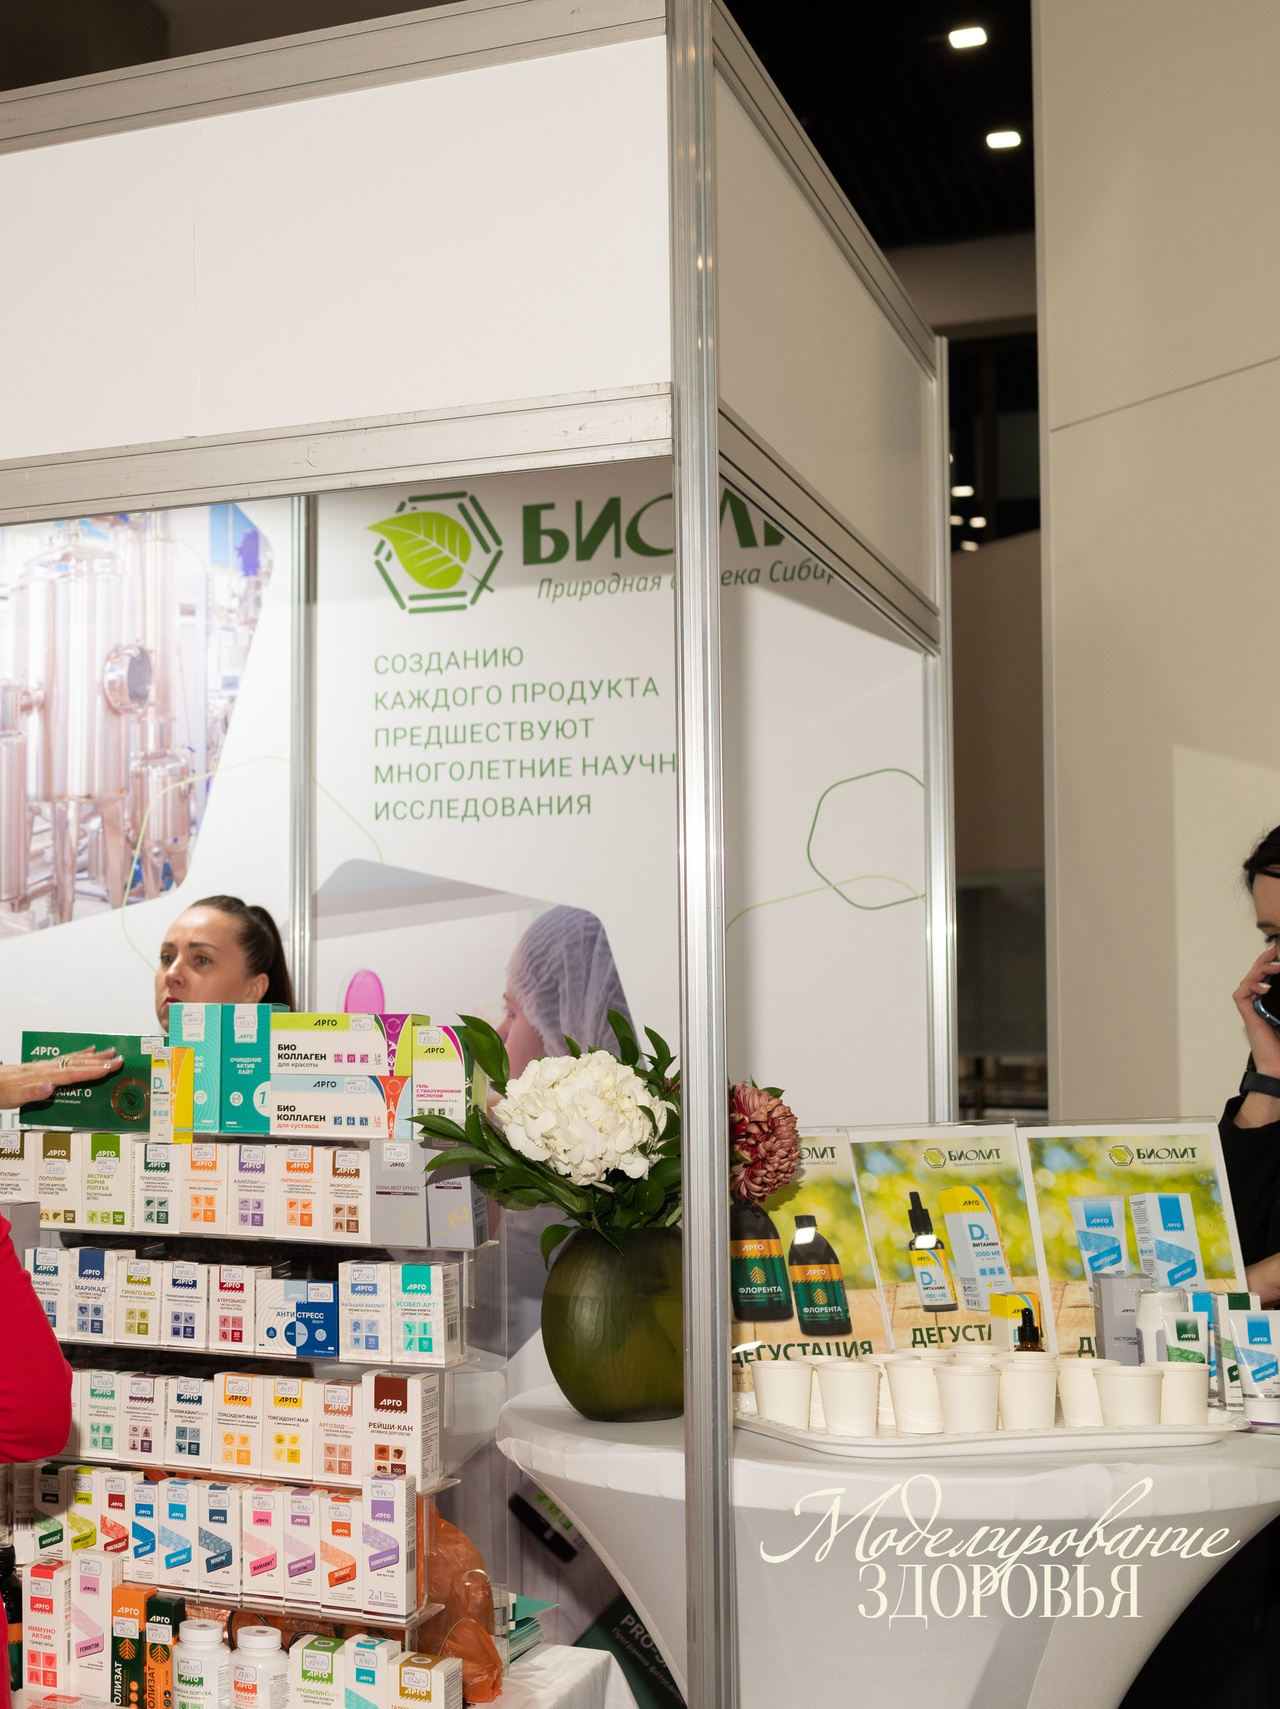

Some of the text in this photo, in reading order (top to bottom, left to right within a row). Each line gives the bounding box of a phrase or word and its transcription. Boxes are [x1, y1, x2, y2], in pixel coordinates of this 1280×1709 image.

[522, 487, 788, 567] БИОЛ
[537, 572, 662, 604] Природная
[769, 556, 839, 584] Сибир
[373, 646, 524, 676] СОЗДАНИЮ
[373, 676, 660, 714] КАЖДОГО ПРОДУКТА
[373, 717, 595, 750] ПРЕДШЕСТВУЮТ
[373, 752, 678, 787] МНОГОЛЕТНИЕ НАУЧН
[373, 794, 592, 822] ИССЛЕДОВАНИЯ
[313, 1019, 338, 1027] АРГО
[30, 1046, 60, 1056] АРГО
[277, 1052, 327, 1061] КОЛЛАГЕН
[259, 1091, 266, 1104] 1
[276, 1114, 326, 1122] КОЛЛАГЕН
[948, 1148, 1001, 1162] БИОЛИТ
[1136, 1147, 1197, 1160] БИОЛИТ
[741, 1244, 765, 1252] АРГО
[806, 1268, 826, 1276] АРГО
[74, 1285, 107, 1293] МАРИКАД
[738, 1285, 783, 1294] ФЛОРЕНТА
[803, 1305, 842, 1314] ФЛОРЕНТА
[732, 1340, 874, 1368] ДЕГУСТАЦИЯ
[278, 1396, 298, 1404] АРГО
[379, 1398, 402, 1407] АРГО
[328, 1404, 349, 1412] АРГО
[368, 1422, 413, 1431] РЕЙШИ-КАН
[252, 1559, 274, 1571] МАМАВИТ
[368, 1590, 383, 1601] 2в1
[117, 1606, 140, 1616] АРГО
[149, 1615, 170, 1624] АРГО
[28, 1625, 56, 1635] ИММУНО
[31, 1632, 52, 1641] АКТИВ
[180, 1675, 199, 1683] АРГО
[306, 1670, 328, 1679] АРГО
[404, 1687, 427, 1696] АРГО
